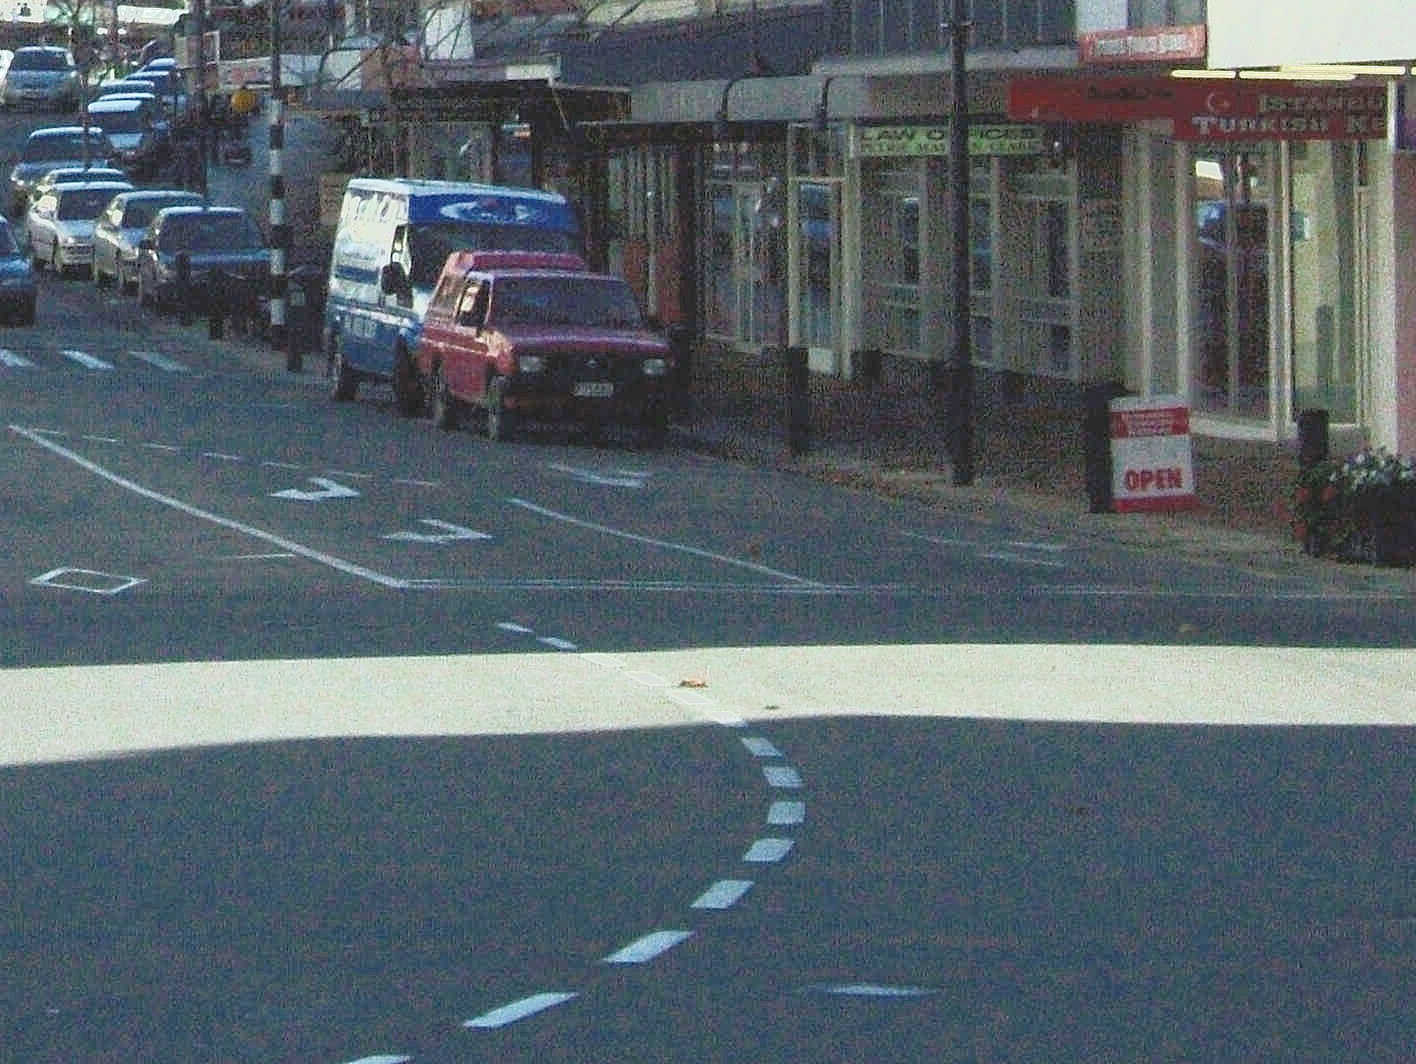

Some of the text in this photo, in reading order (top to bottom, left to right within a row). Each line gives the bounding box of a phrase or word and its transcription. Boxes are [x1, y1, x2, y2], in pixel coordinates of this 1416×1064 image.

[861, 128, 1036, 141] LAW OICES
[1125, 468, 1183, 491] OPEN
